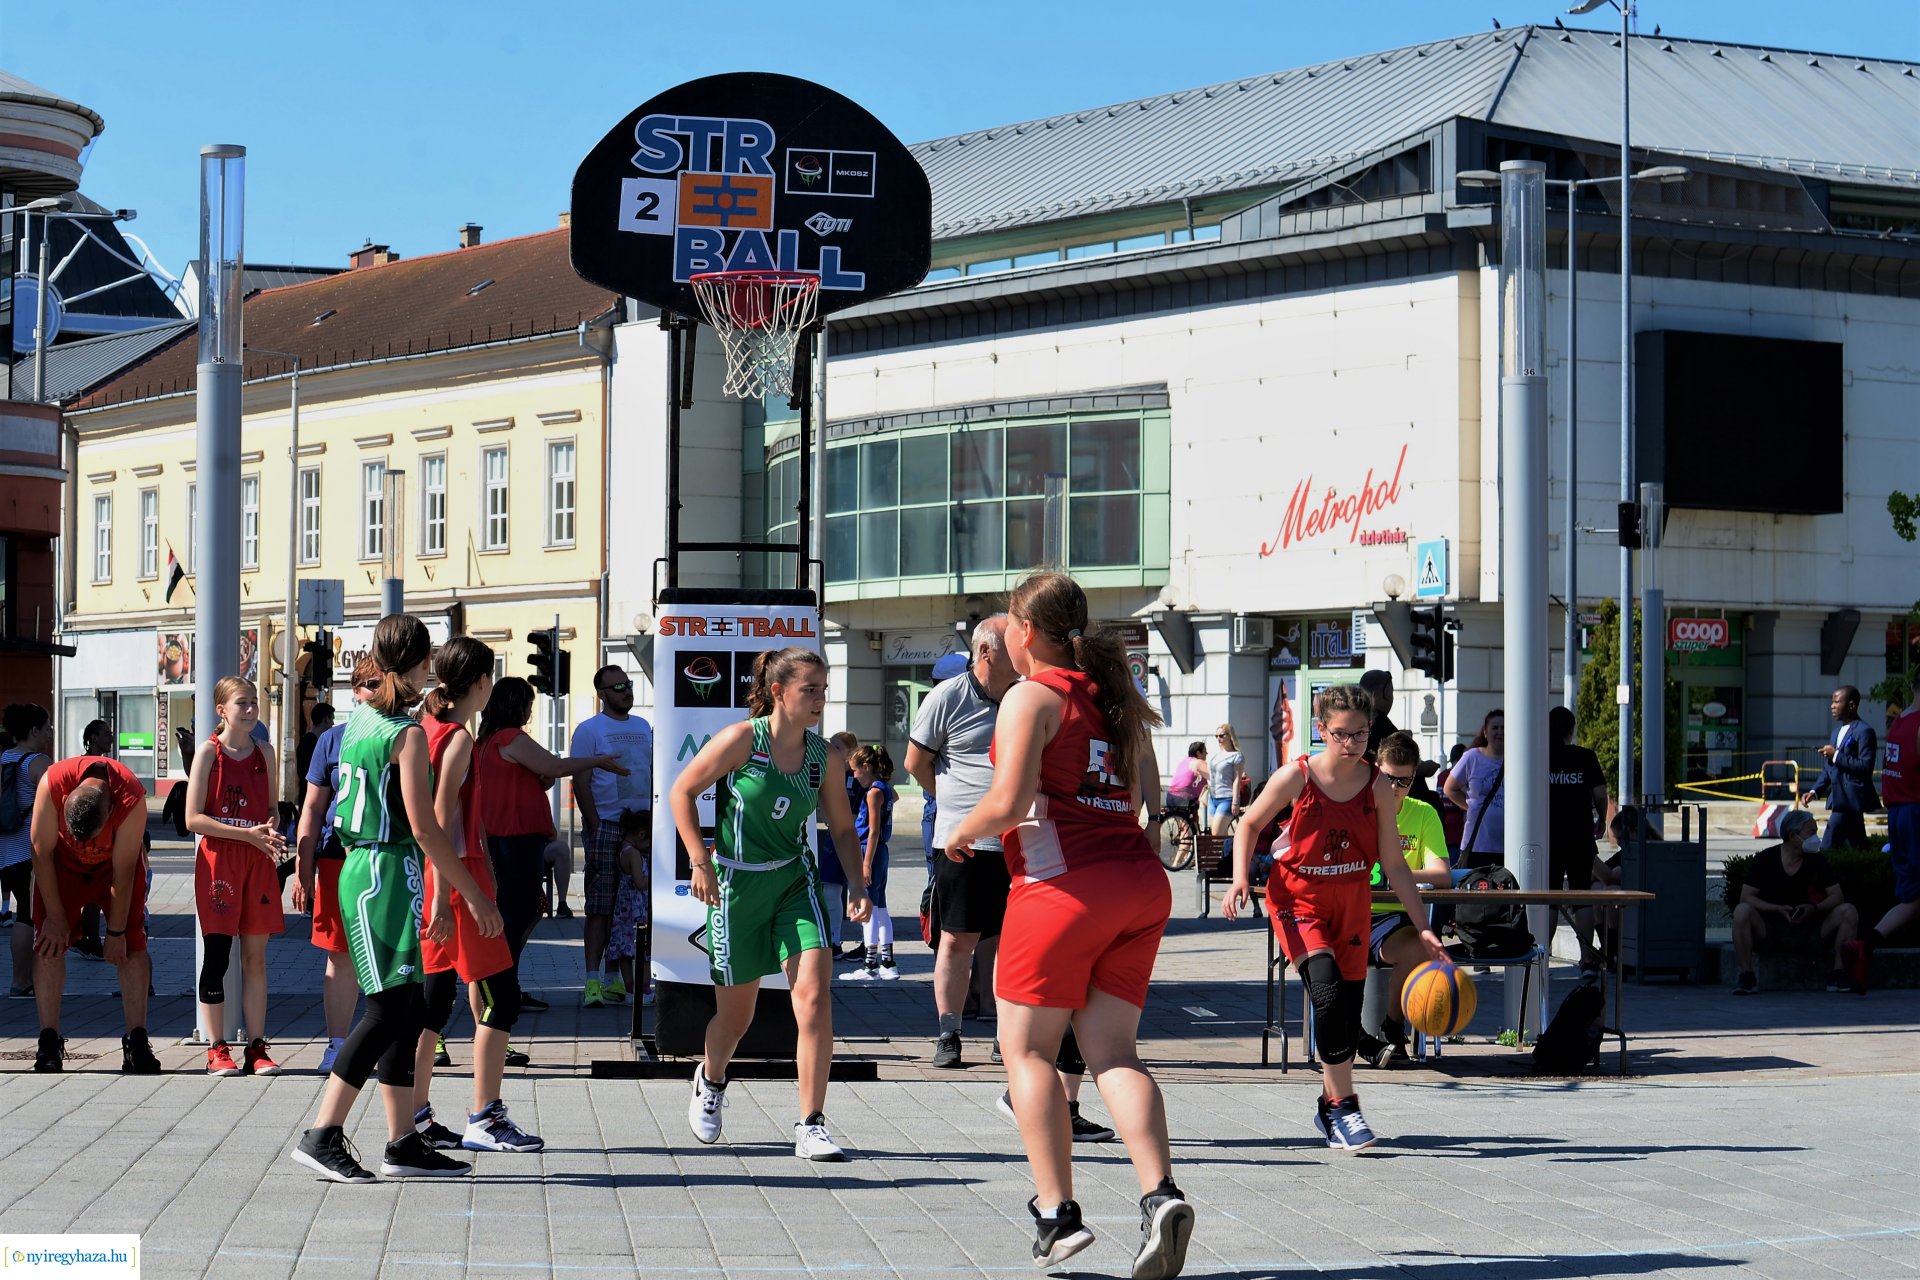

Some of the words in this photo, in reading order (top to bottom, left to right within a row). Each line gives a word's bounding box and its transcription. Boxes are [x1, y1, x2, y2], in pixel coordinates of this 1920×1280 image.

[835, 169, 869, 177] MKOSZ
[634, 191, 660, 221] 2
[814, 217, 853, 233] TOTI
[212, 356, 225, 364] 36
[1523, 368, 1536, 376] 36
[1261, 443, 1408, 557] Metropol
[659, 616, 816, 638] STREETBALL
[1676, 622, 1724, 643] coop
[888, 636, 931, 660] Firenze
[1673, 641, 1710, 652] szuper
[334, 762, 367, 833] 21
[771, 796, 791, 820] 9
[1299, 860, 1367, 875] STREETBALL
